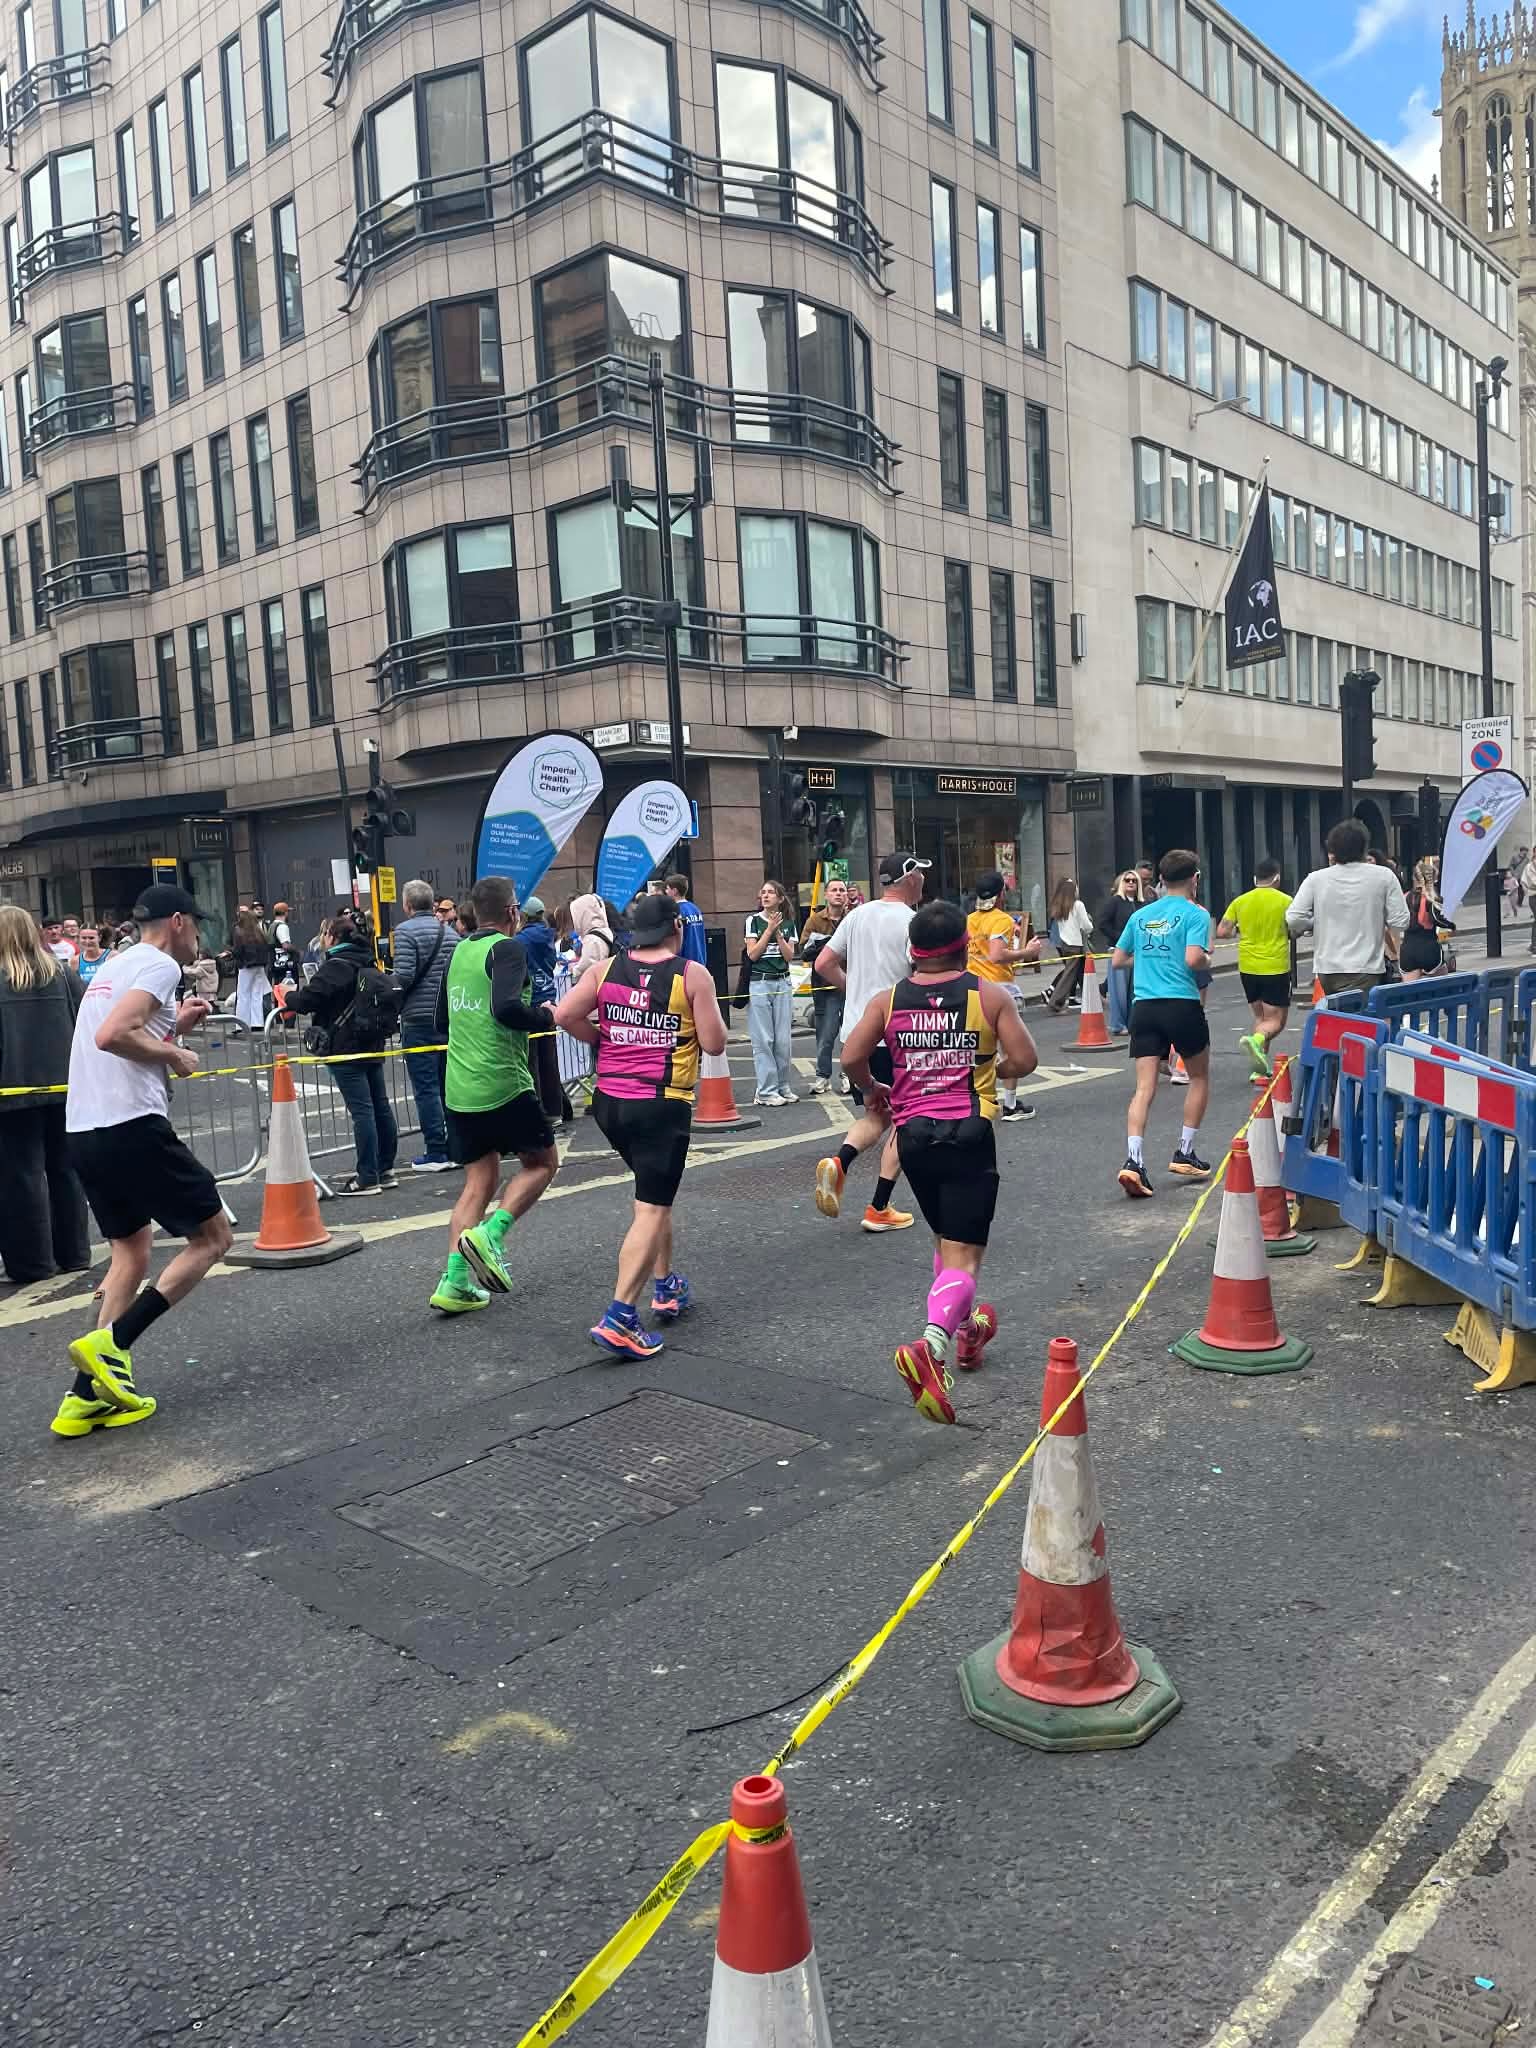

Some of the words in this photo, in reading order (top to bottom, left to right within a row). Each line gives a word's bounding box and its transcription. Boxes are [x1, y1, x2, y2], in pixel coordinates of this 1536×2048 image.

[1234, 617, 1278, 648] IAC
[1465, 719, 1508, 730] Controlled
[655, 733, 671, 741] STREE
[1471, 728, 1502, 739] ZONE
[541, 763, 577, 776] Imperial
[540, 773, 569, 784] Health
[811, 771, 833, 786] H+H
[539, 782, 571, 795] Charity
[646, 807, 668, 817] Health
[647, 800, 674, 811] Imperial
[645, 814, 669, 825] Charity
[450, 985, 482, 1012] Felix
[629, 990, 648, 1007] DC
[606, 1003, 642, 1025] YOUNG
[644, 1011, 679, 1030] LIVES
[910, 1011, 959, 1031] YIMMY
[627, 1029, 674, 1045] CANCER
[898, 1032, 940, 1049] YOUNG
[942, 1032, 977, 1049] LIVES
[924, 1050, 973, 1068] CANCER
